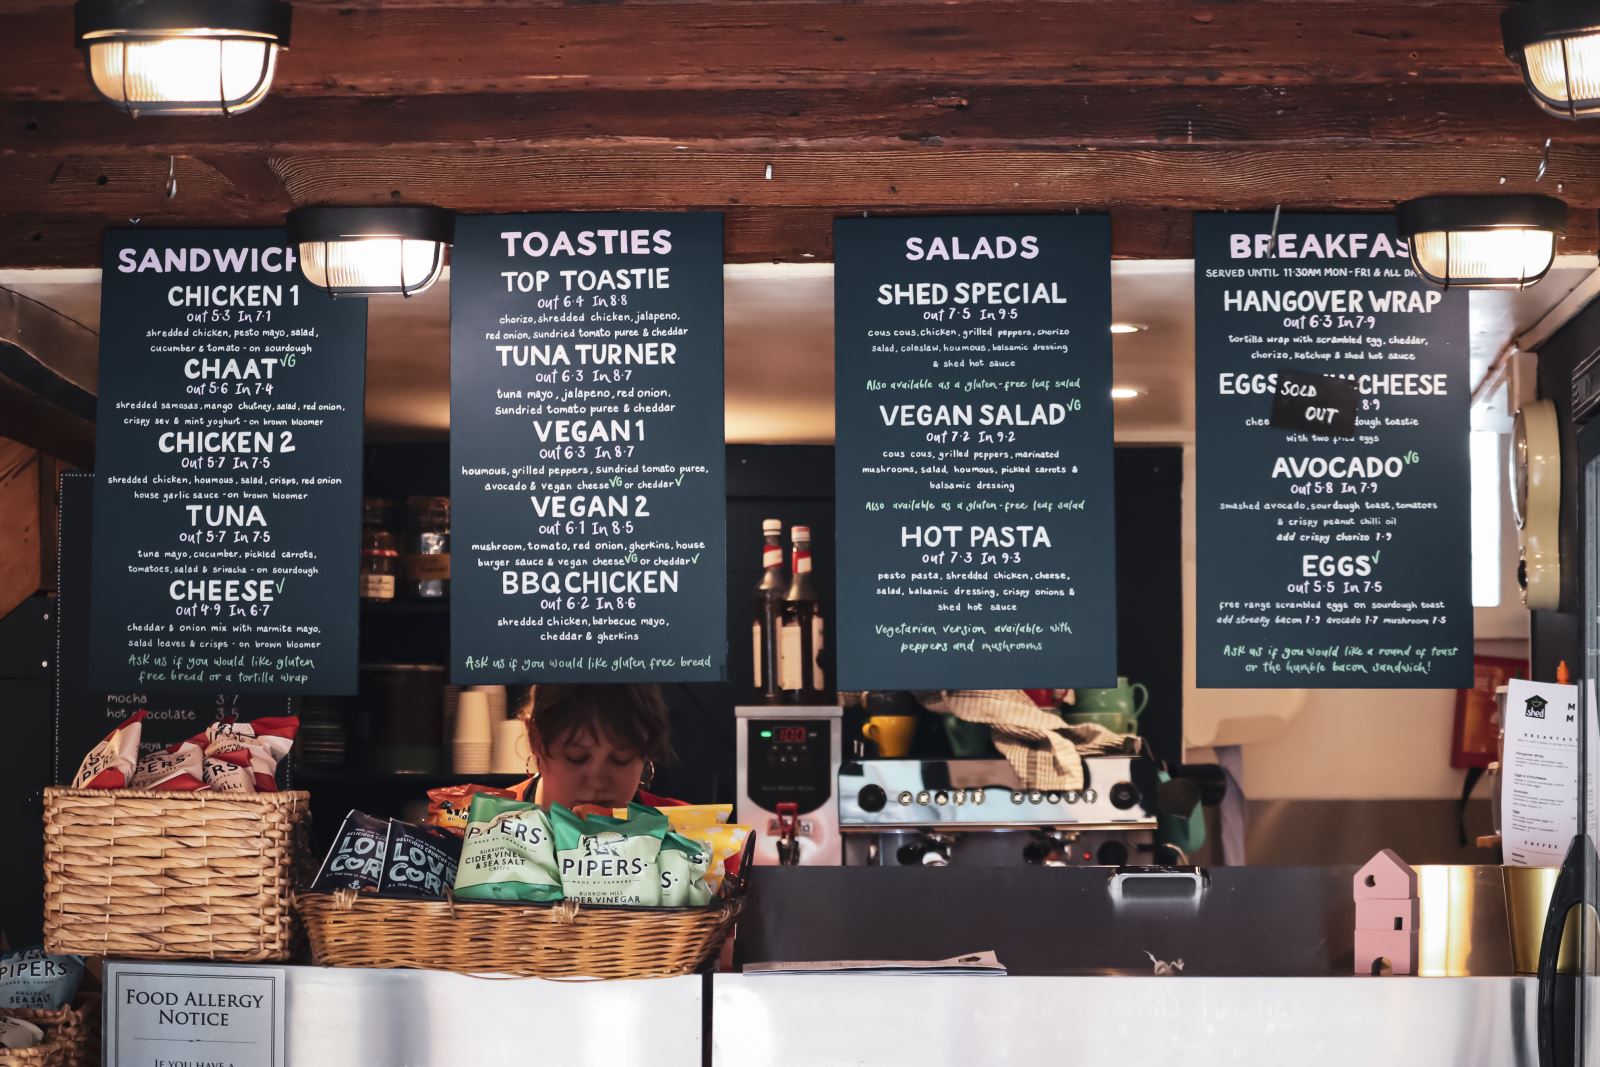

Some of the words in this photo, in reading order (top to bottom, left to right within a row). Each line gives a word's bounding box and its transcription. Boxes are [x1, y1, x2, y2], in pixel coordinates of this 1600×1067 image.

[501, 229, 672, 257] TOASTIES
[906, 235, 1039, 261] SALADS
[1230, 233, 1410, 259] BREAKFAS
[118, 247, 296, 273] SANDWICH
[501, 270, 550, 292] TOP
[560, 267, 670, 291] TOASTIE
[1206, 268, 1245, 278] SERVED
[1247, 268, 1280, 277] UNTIL
[1383, 268, 1401, 277] ALL
[168, 285, 282, 307] CHICKEN
[289, 285, 298, 306] 1
[877, 283, 948, 305] SHED
[953, 282, 1067, 304] SPECIAL
[1224, 290, 1364, 313] HANGOVER
[1368, 290, 1442, 313] WRAP
[538, 312, 585, 323] shredded
[980, 309, 996, 320] In
[146, 327, 189, 337] shredded
[234, 328, 259, 339] pesto
[486, 330, 500, 340] red
[532, 328, 575, 339] sundried
[578, 327, 611, 337] tomato
[614, 329, 639, 340] puree
[651, 327, 688, 337] cheddar
[962, 327, 992, 339] grilled
[1037, 328, 1070, 336] chorizo
[1228, 335, 1263, 343] tortilla
[1267, 336, 1290, 345] wrap
[1293, 335, 1313, 343] with
[1315, 335, 1362, 344] scrambled
[495, 344, 571, 366] TUNA
[575, 342, 676, 365] TURNER
[184, 358, 278, 379] CHAAT
[1280, 381, 1317, 397] SOLD
[1358, 373, 1447, 395] CHEESE
[879, 405, 972, 426] VEGAN
[979, 403, 1066, 426] SALAD
[1305, 406, 1339, 424] OUT
[533, 419, 630, 443] VEGAN
[635, 419, 644, 441] 1
[158, 431, 273, 453] CHICKEN
[280, 430, 296, 453] 2
[1272, 456, 1403, 478] AVOCADO
[531, 495, 628, 518] VEGAN
[635, 495, 650, 517] 2
[1220, 501, 1260, 510] smashed
[1310, 500, 1360, 513] sourdough
[186, 505, 267, 527] TUNA
[901, 526, 963, 547] HOT
[970, 526, 1051, 548] PASTA
[1276, 532, 1295, 541] add
[1299, 532, 1330, 544] crispy
[1336, 532, 1370, 541] chorizo
[137, 550, 159, 558] tuna
[244, 550, 276, 559] pickled
[1303, 555, 1371, 577] EGGS
[502, 571, 561, 595] BBQ
[565, 570, 678, 594] CHICKEN
[878, 572, 906, 581] pesto
[946, 571, 988, 580] shredded
[169, 580, 274, 601] CHEESE
[127, 623, 165, 631] cheddar
[179, 624, 206, 632] onion
[232, 624, 252, 632] with
[256, 624, 292, 632] marmite
[497, 616, 543, 626] shredded
[592, 616, 637, 626] barbecue
[1245, 664, 1258, 672] or
[1263, 660, 1281, 674] the
[1286, 660, 1326, 674] humble
[1332, 661, 1368, 673] bacon
[1372, 660, 1431, 675] sandwich!
[138, 671, 166, 684] free
[171, 670, 203, 682] bread
[209, 673, 222, 681] or
[225, 674, 232, 682] a
[238, 671, 274, 683] tortilla
[280, 673, 308, 685] wrap
[107, 708, 127, 718] hot
[1526, 707, 1544, 718] shed
[465, 854, 492, 865] CIDER
[483, 860, 500, 868] SEA
[501, 859, 526, 867] SALT
[596, 896, 641, 904] VINEGAR
[10, 996, 29, 1004] SEA
[126, 989, 179, 1006] FOOD
[184, 992, 264, 1009] ALLERGY
[159, 1010, 229, 1027] NOTICE
